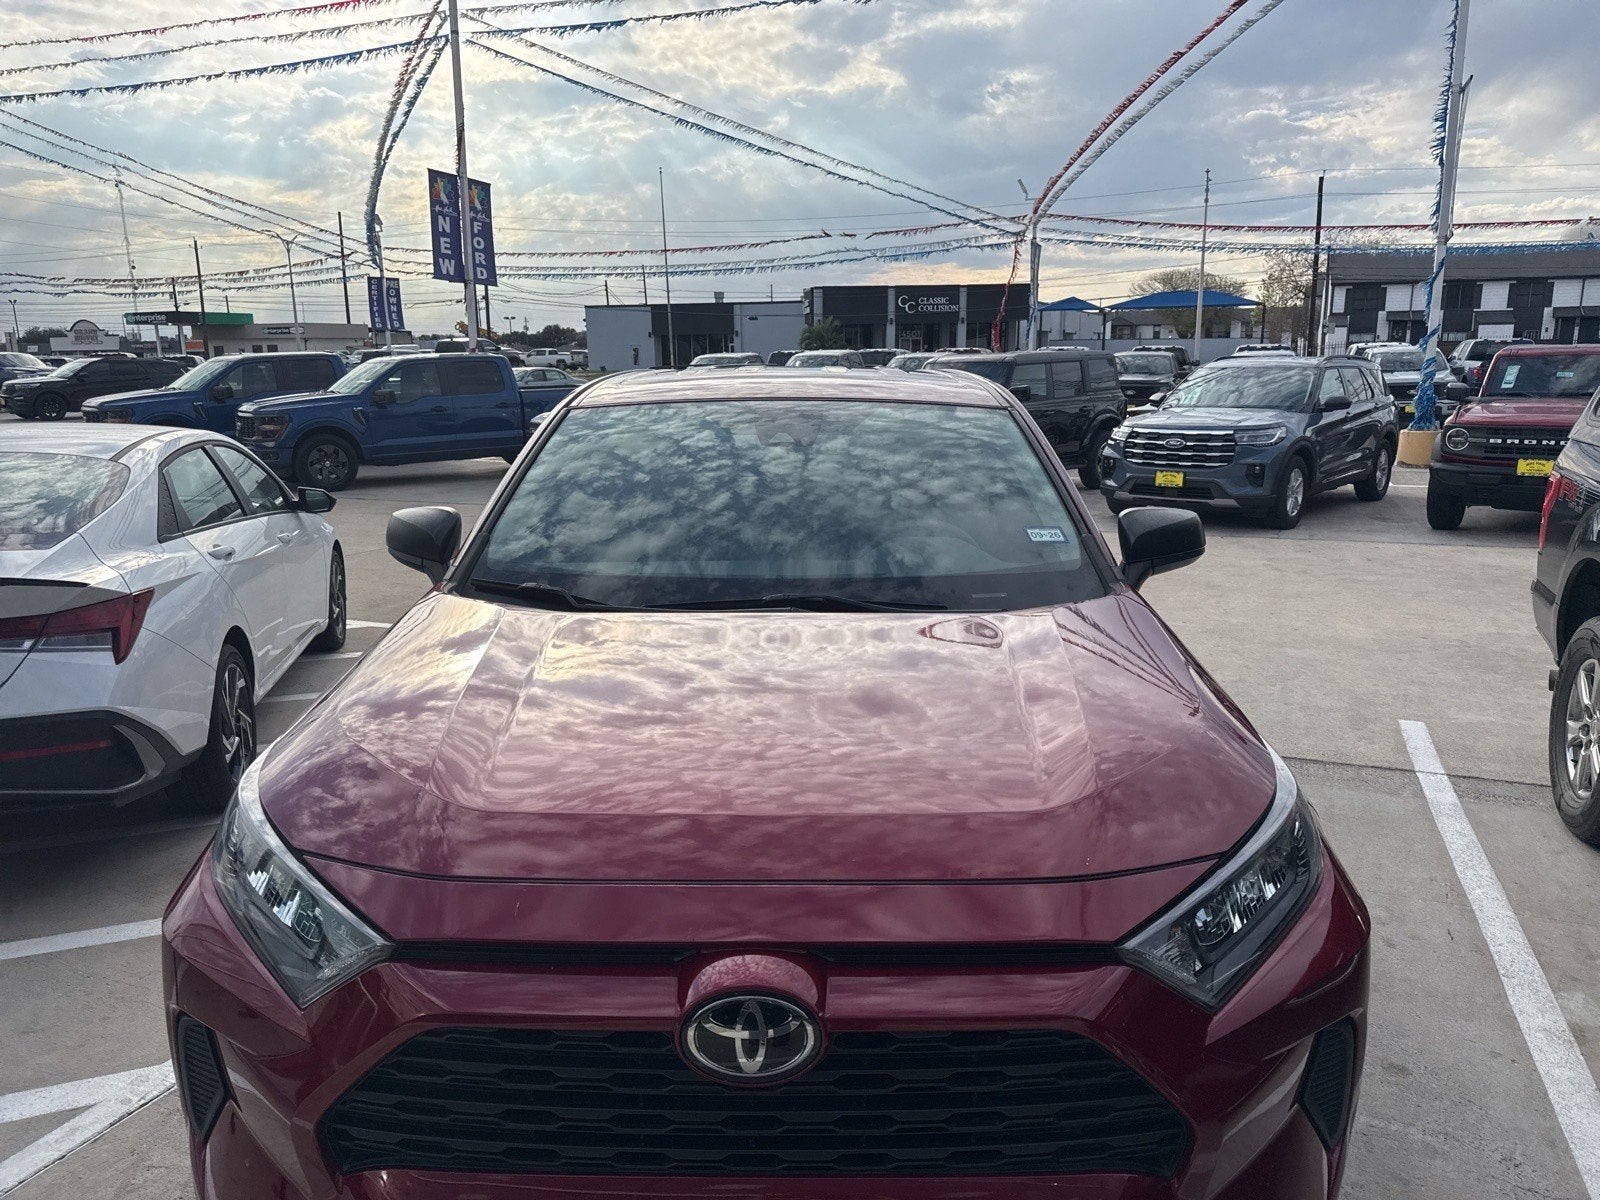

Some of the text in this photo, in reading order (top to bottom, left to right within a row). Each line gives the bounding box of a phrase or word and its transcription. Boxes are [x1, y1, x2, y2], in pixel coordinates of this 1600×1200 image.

[438, 215, 455, 275] NEW
[473, 221, 488, 279] FORD
[371, 278, 382, 328] CERTIFIED
[386, 280, 399, 289] PRE
[127, 314, 167, 322] enterprise
[389, 289, 400, 328] OWNED
[1489, 438, 1569, 446] BRONC
